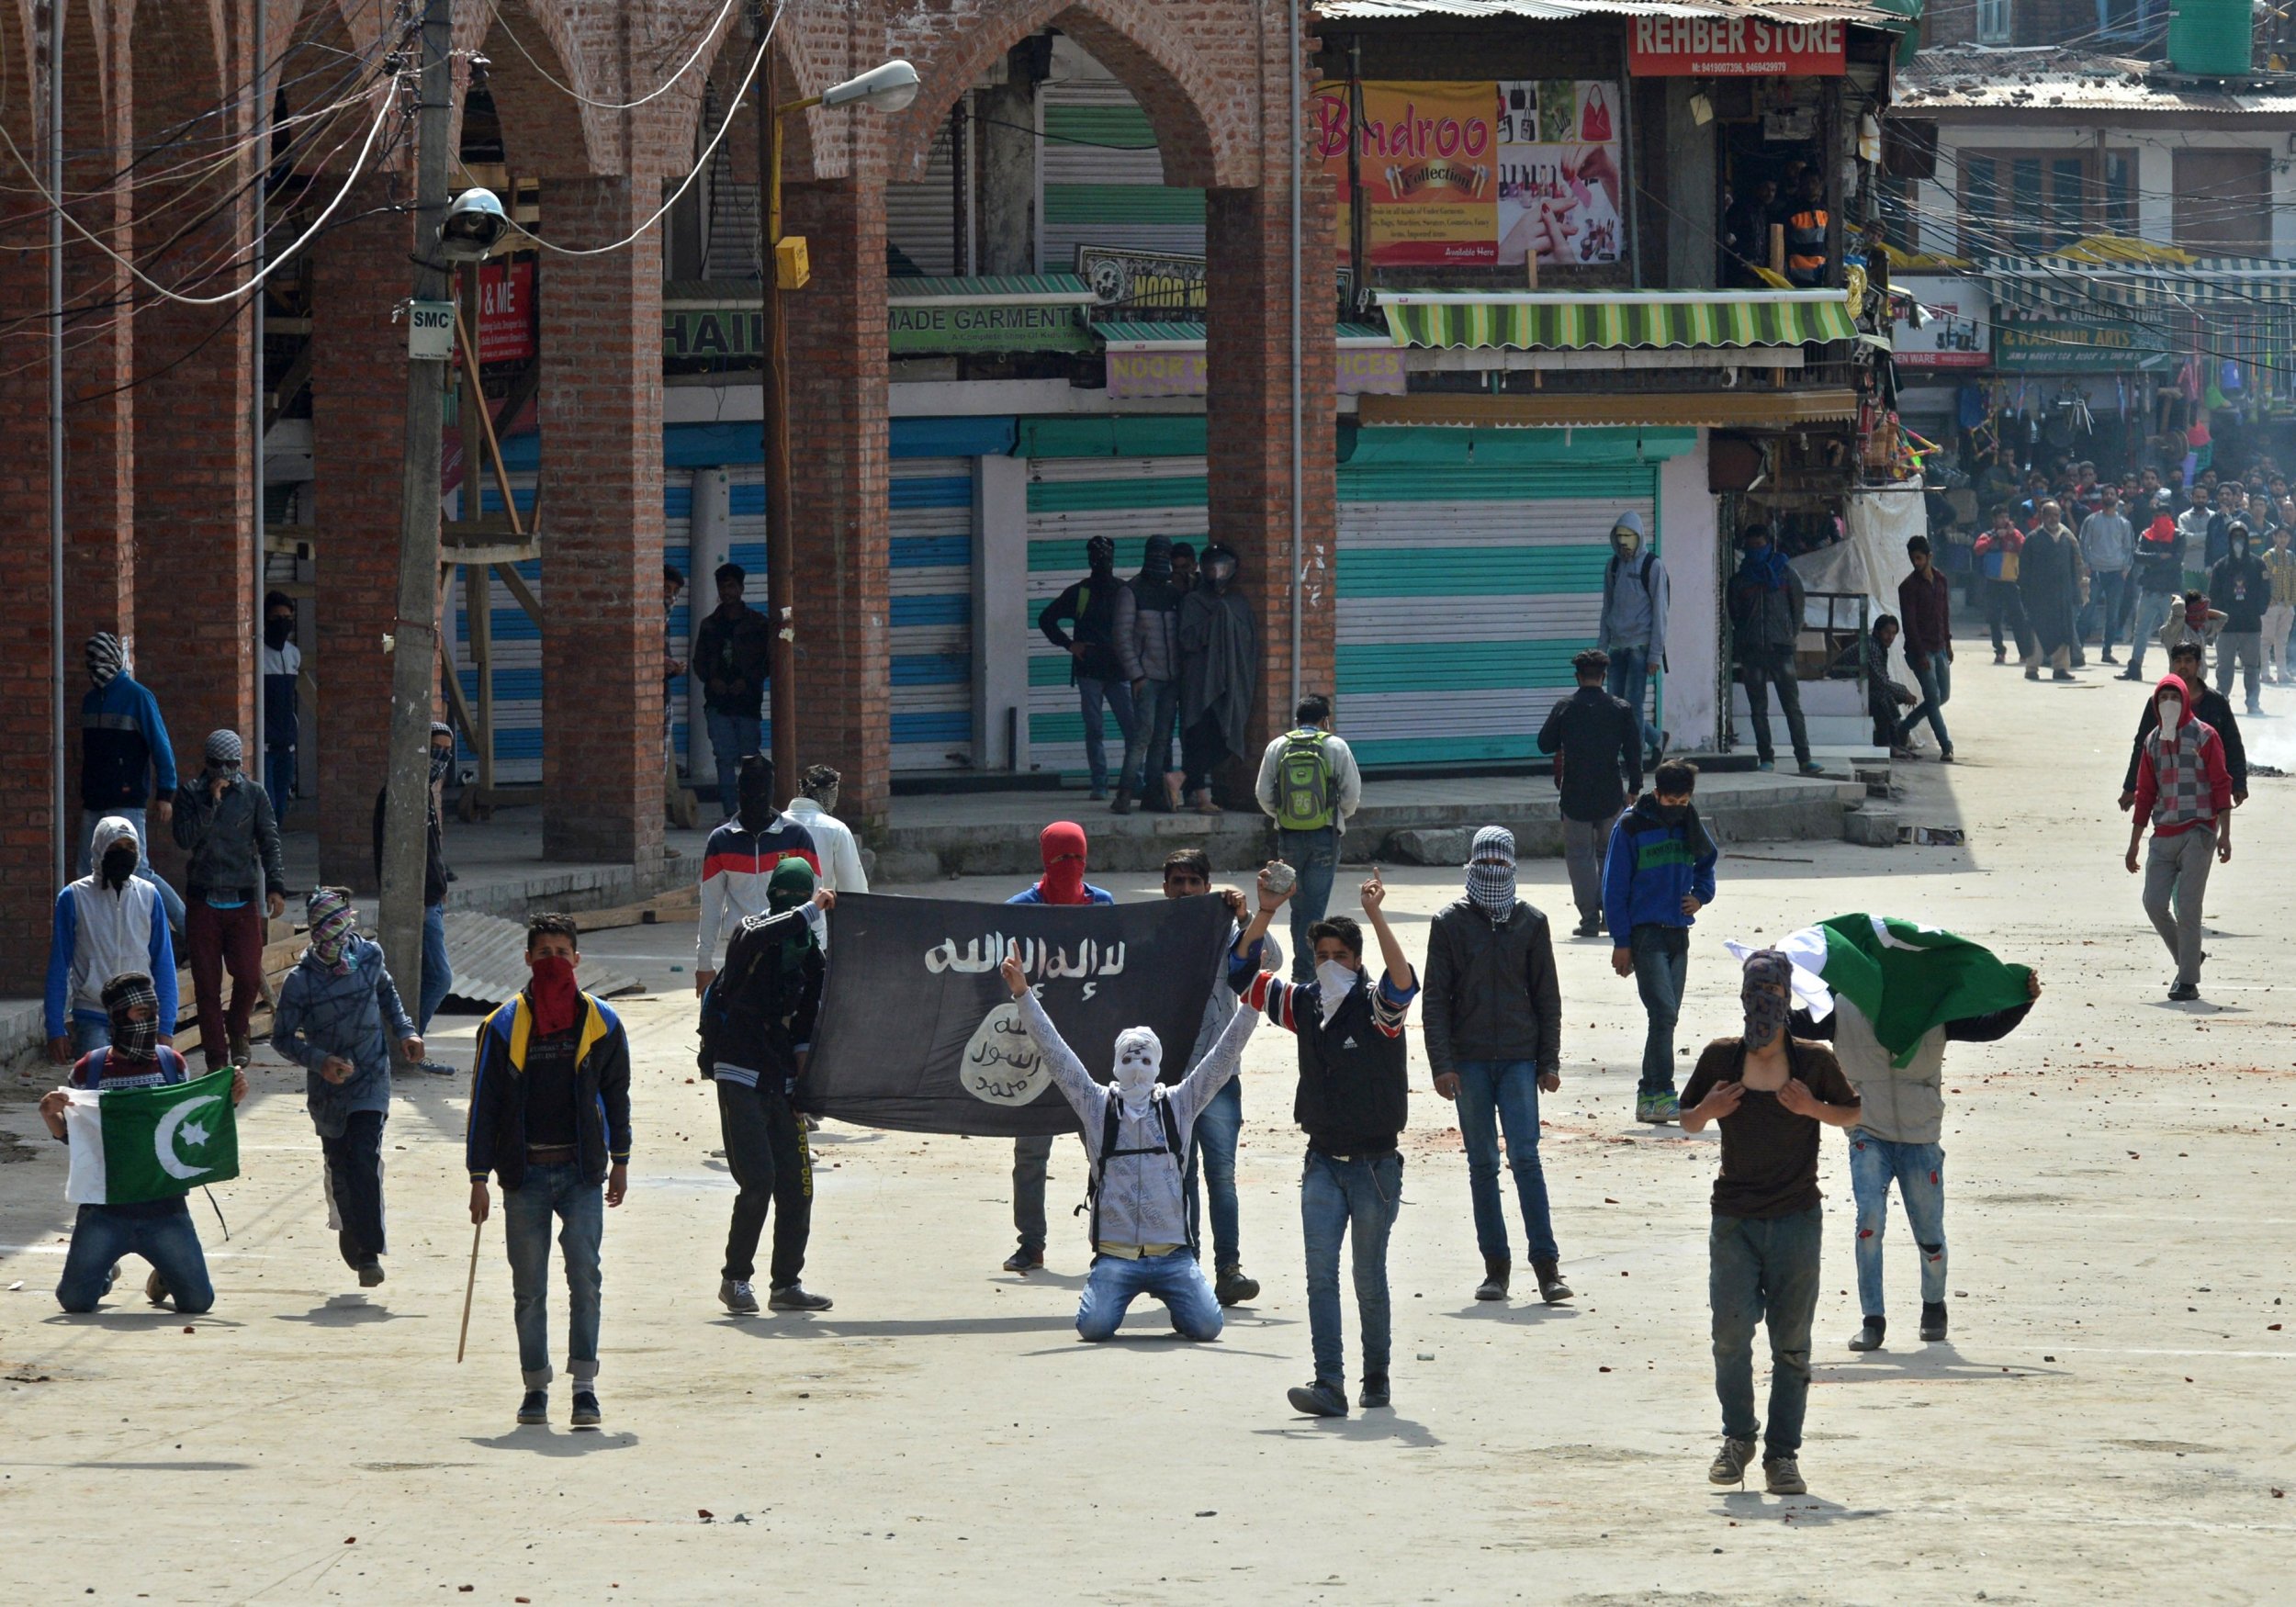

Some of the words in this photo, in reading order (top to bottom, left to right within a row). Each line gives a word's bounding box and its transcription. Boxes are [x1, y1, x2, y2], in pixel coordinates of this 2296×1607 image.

[1637, 16, 1745, 53] REHBER
[1754, 18, 1841, 53] STORE
[1312, 94, 1488, 158] Bndroo
[1404, 165, 1470, 188] Collection
[1445, 246, 1476, 256] Available
[1477, 246, 1494, 256] Here
[485, 283, 494, 316] &
[497, 281, 515, 314] ME
[1133, 275, 1185, 308] NOOR
[414, 311, 449, 328] SMC
[954, 308, 1084, 330] GARMENTS
[2126, 305, 2164, 321] STORE
[2002, 330, 2014, 345] &
[2019, 330, 2088, 346] KASHMIR
[2095, 331, 2130, 346] ARTS
[1111, 355, 1186, 379] NOOR
[1910, 354, 1936, 364] WARE
[924, 930, 1005, 974] الله
[972, 1040, 1041, 1077] رسول
[975, 1075, 1028, 1097] محمد
